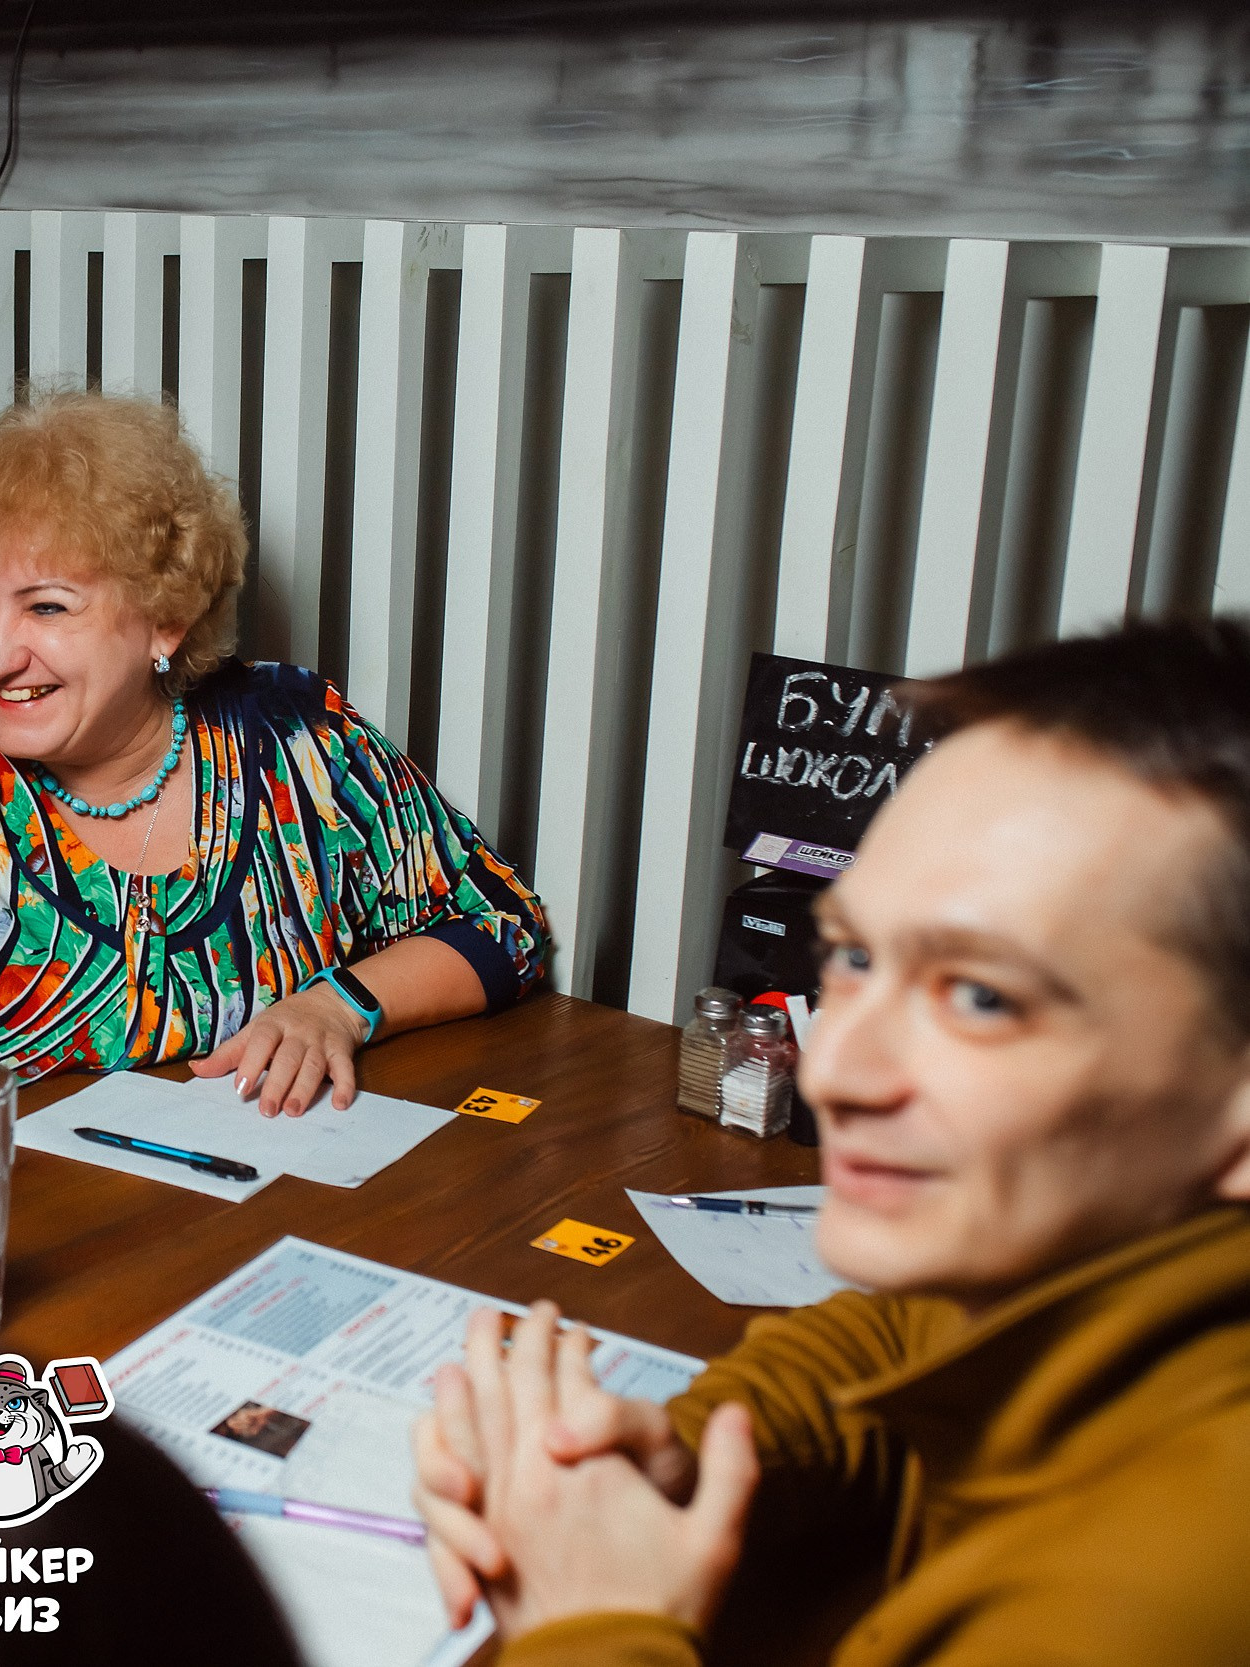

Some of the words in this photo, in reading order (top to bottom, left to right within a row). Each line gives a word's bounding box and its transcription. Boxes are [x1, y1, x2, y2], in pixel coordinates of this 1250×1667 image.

[777, 671, 934, 753] БУМ
[798, 845, 854, 864] ШЕЙКЕР
[462, 1095, 498, 1113] 43
[581, 1237, 622, 1257] 46
